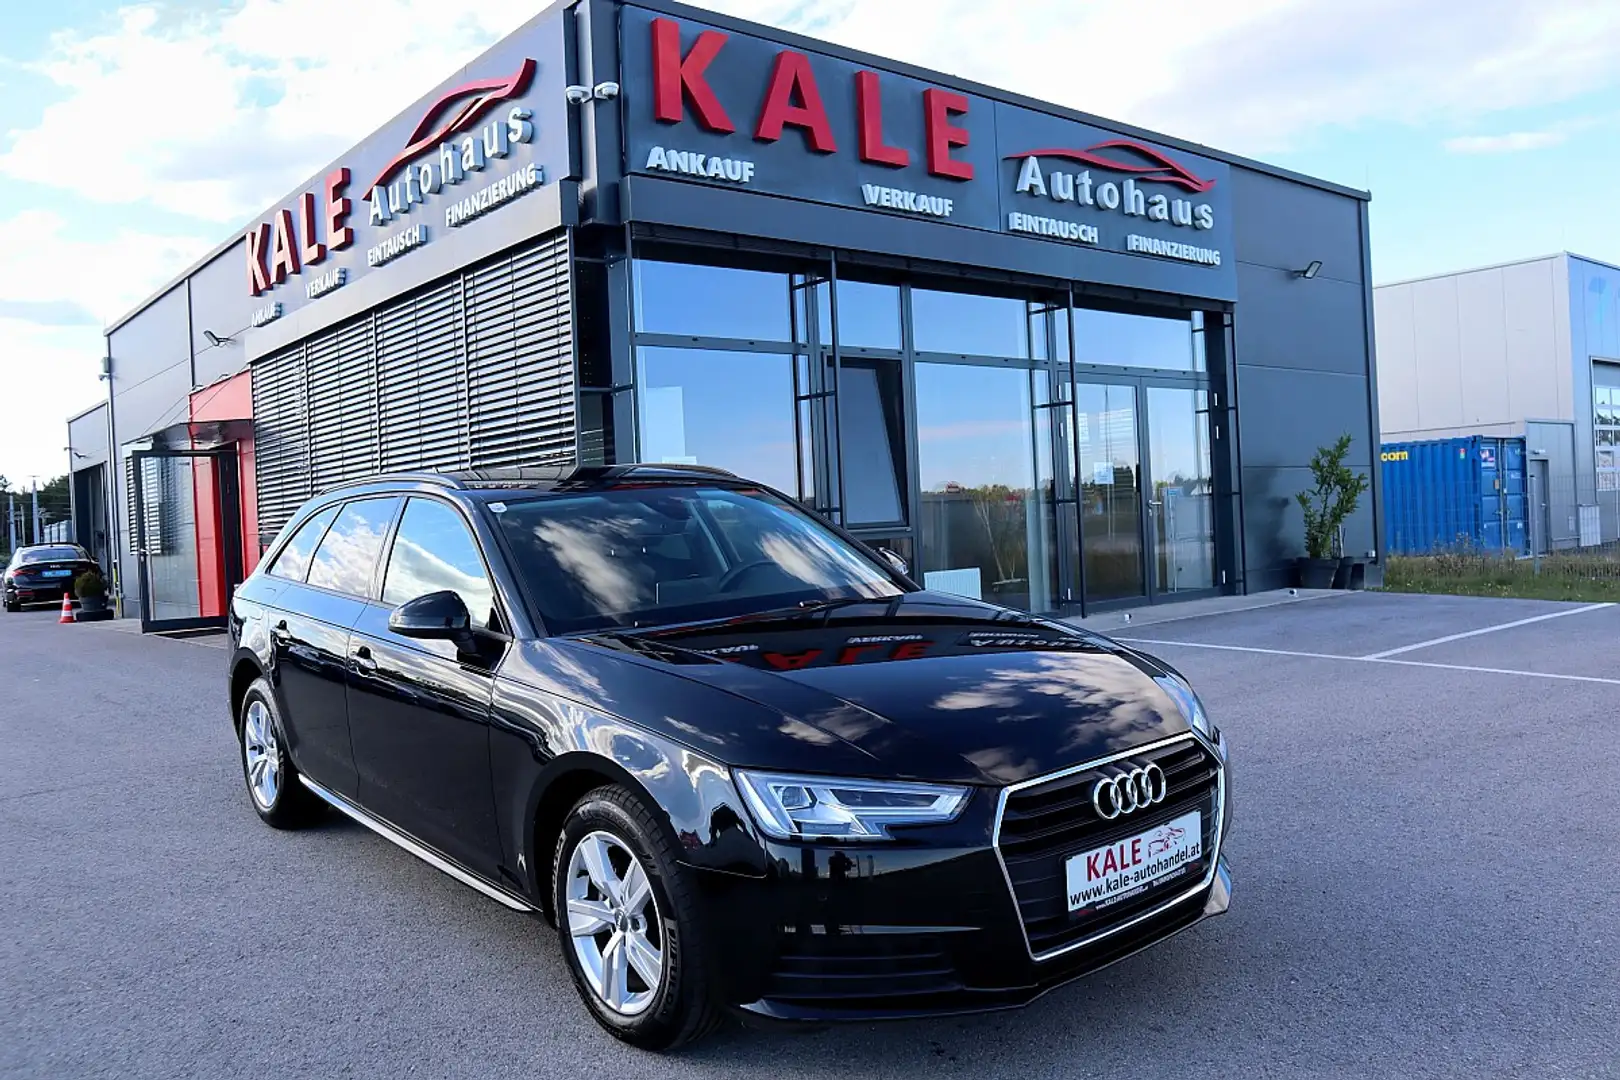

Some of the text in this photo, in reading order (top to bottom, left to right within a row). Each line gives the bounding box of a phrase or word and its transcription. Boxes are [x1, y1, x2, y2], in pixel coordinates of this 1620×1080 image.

[651, 17, 974, 181] KALE
[369, 106, 533, 227] Autohaus
[646, 146, 1221, 266] ANKAUF VERKAUF EINTAUSCH FINANZIERUNG
[1016, 155, 1214, 229] Autohaus
[246, 167, 354, 297] KALE
[305, 267, 346, 299] VERKAUF
[367, 224, 427, 267] EINTAUSCH
[445, 162, 543, 228] FINANZIERUNG
[1070, 842, 1200, 906] www.kale-autohandel.at
[1086, 838, 1142, 881] KALE
